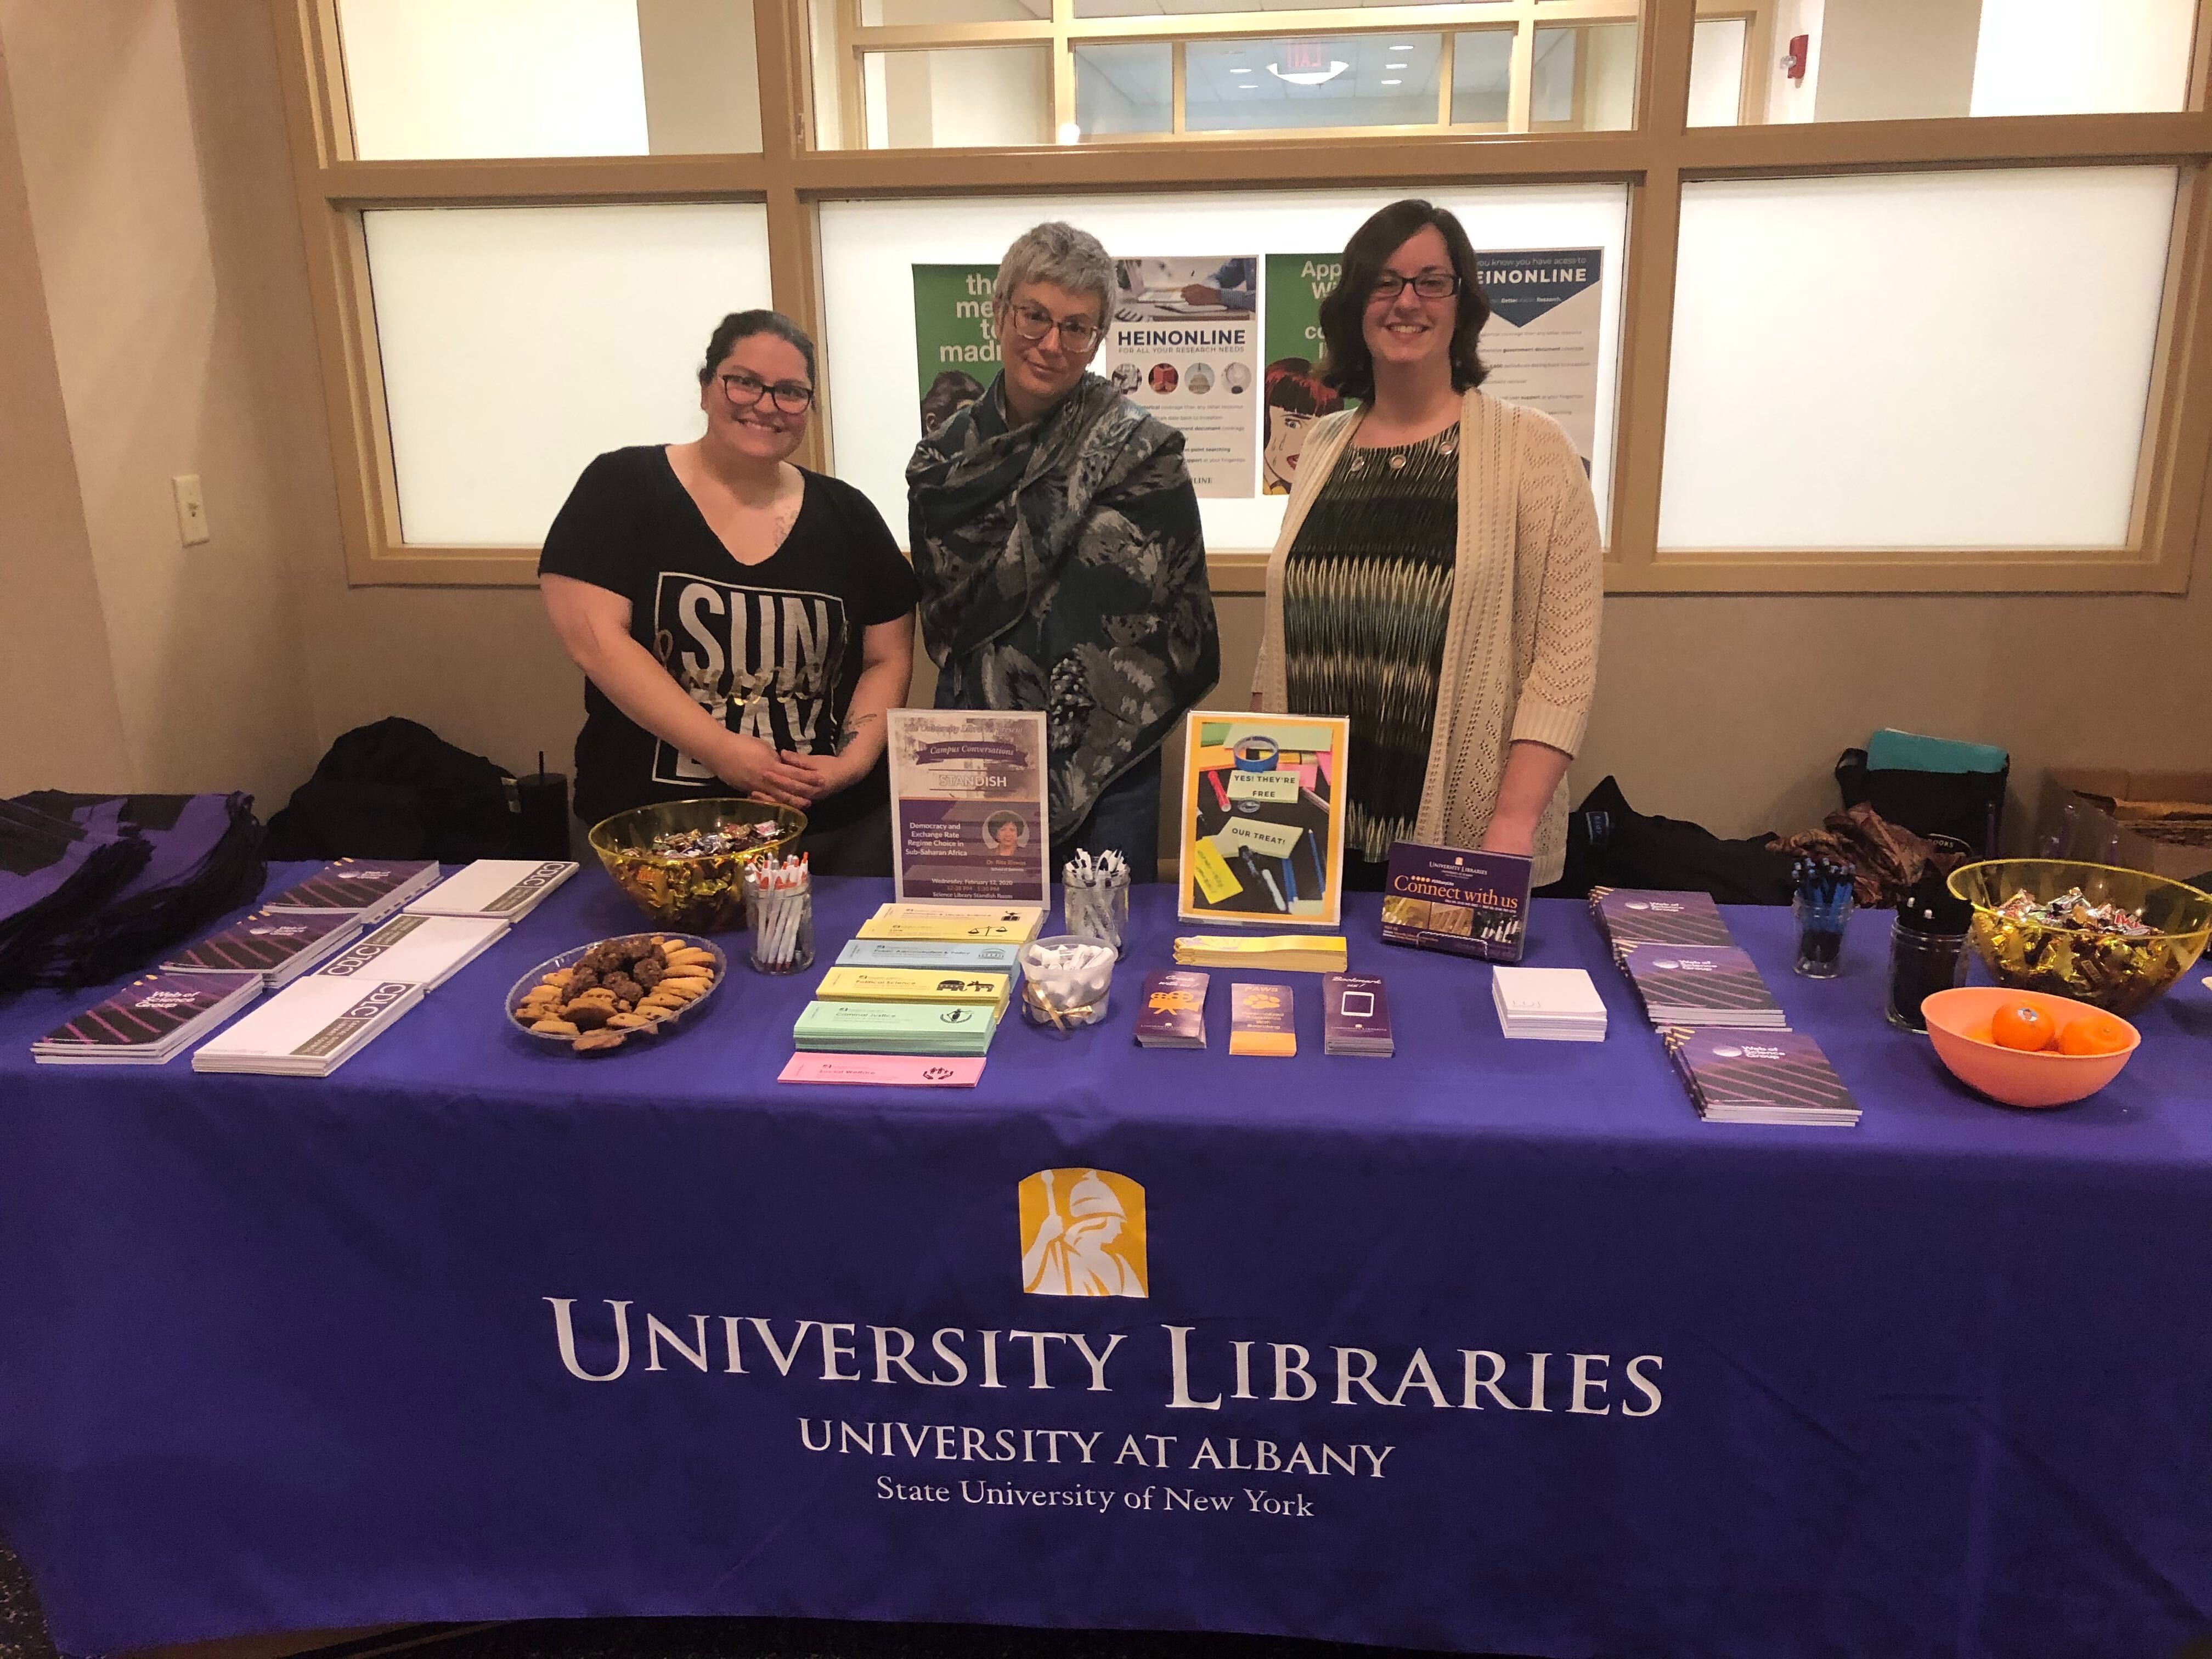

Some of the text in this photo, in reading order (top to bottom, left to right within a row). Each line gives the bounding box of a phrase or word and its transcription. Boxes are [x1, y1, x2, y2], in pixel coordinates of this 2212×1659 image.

[1301, 261, 1342, 281] App
[1118, 330, 1245, 346] HEINONLINE
[679, 583, 829, 692] SUN
[930, 745, 1014, 756] Campus Conversations
[939, 775, 1007, 788] STANDISH
[1234, 774, 1296, 785] YES! THEY'RE
[1252, 790, 1276, 798] FREE
[910, 822, 947, 830] Democracy
[911, 831, 943, 839] Exchange
[908, 839, 933, 848] Regime
[1231, 827, 1286, 845] OUR TREAT!
[523, 863, 566, 886] CDLC
[1394, 874, 1460, 900] Connect
[1465, 888, 1498, 906] with
[1502, 897, 1519, 909] us
[327, 946, 381, 975] CDLC
[350, 984, 407, 1016] CDLC
[542, 1296, 1664, 1417] UNIVERSITY LIBRARIES
[799, 1418, 1396, 1478] UNIVERSITY AT ALBANY
[877, 1476, 1314, 1517] State University of New York
